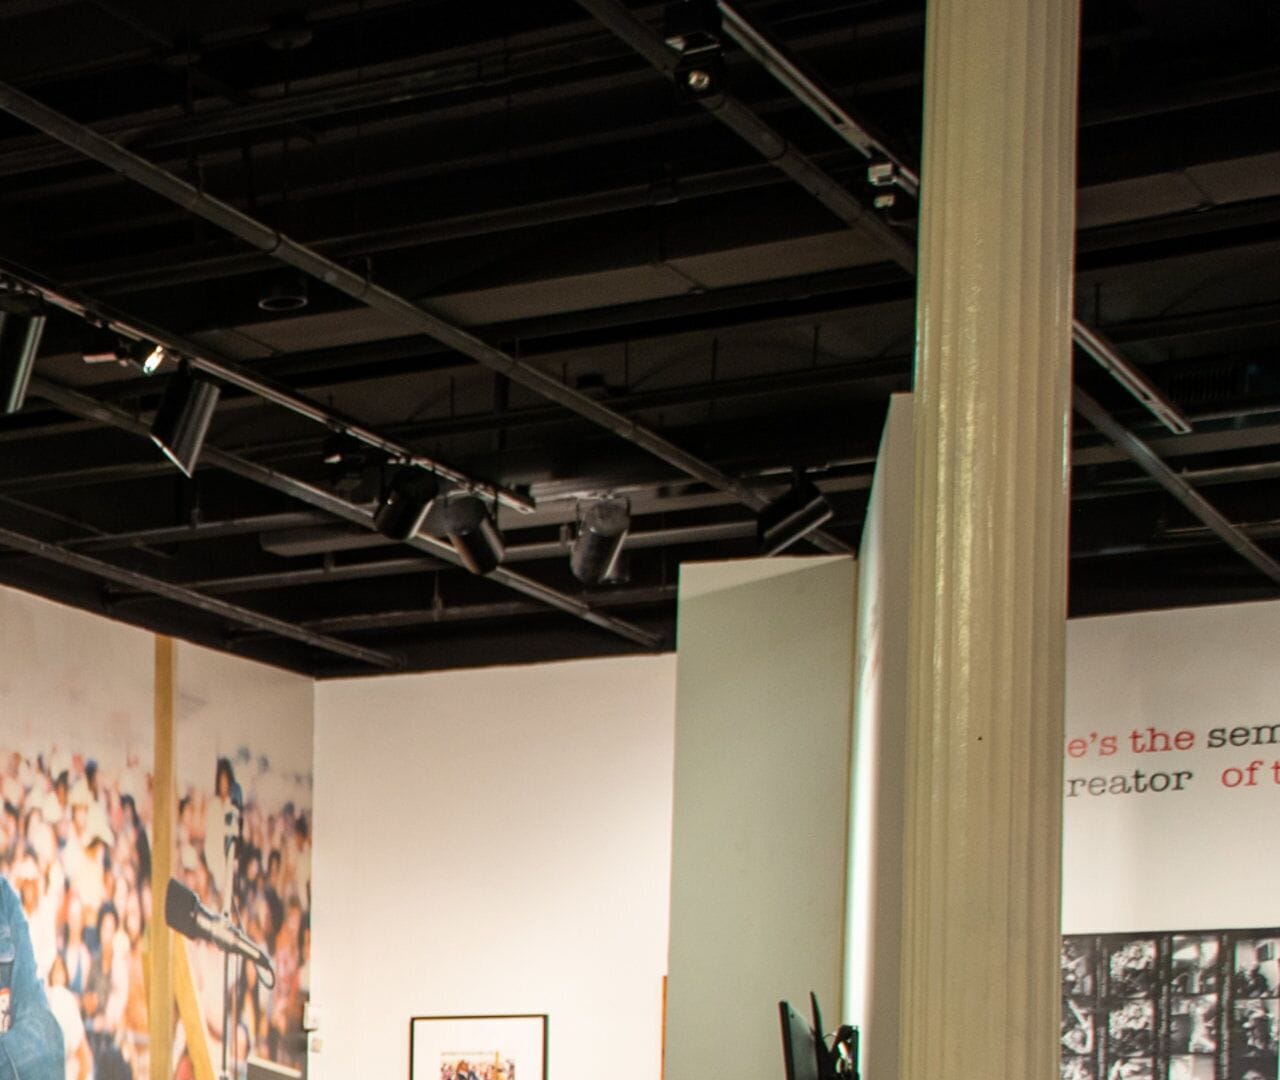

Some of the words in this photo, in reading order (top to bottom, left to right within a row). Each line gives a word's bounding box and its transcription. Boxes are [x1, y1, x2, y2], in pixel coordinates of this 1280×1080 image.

[1128, 727, 1195, 753] the
[1207, 724, 1280, 748] sem
[1066, 770, 1193, 797] reator
[1221, 760, 1264, 787] of
